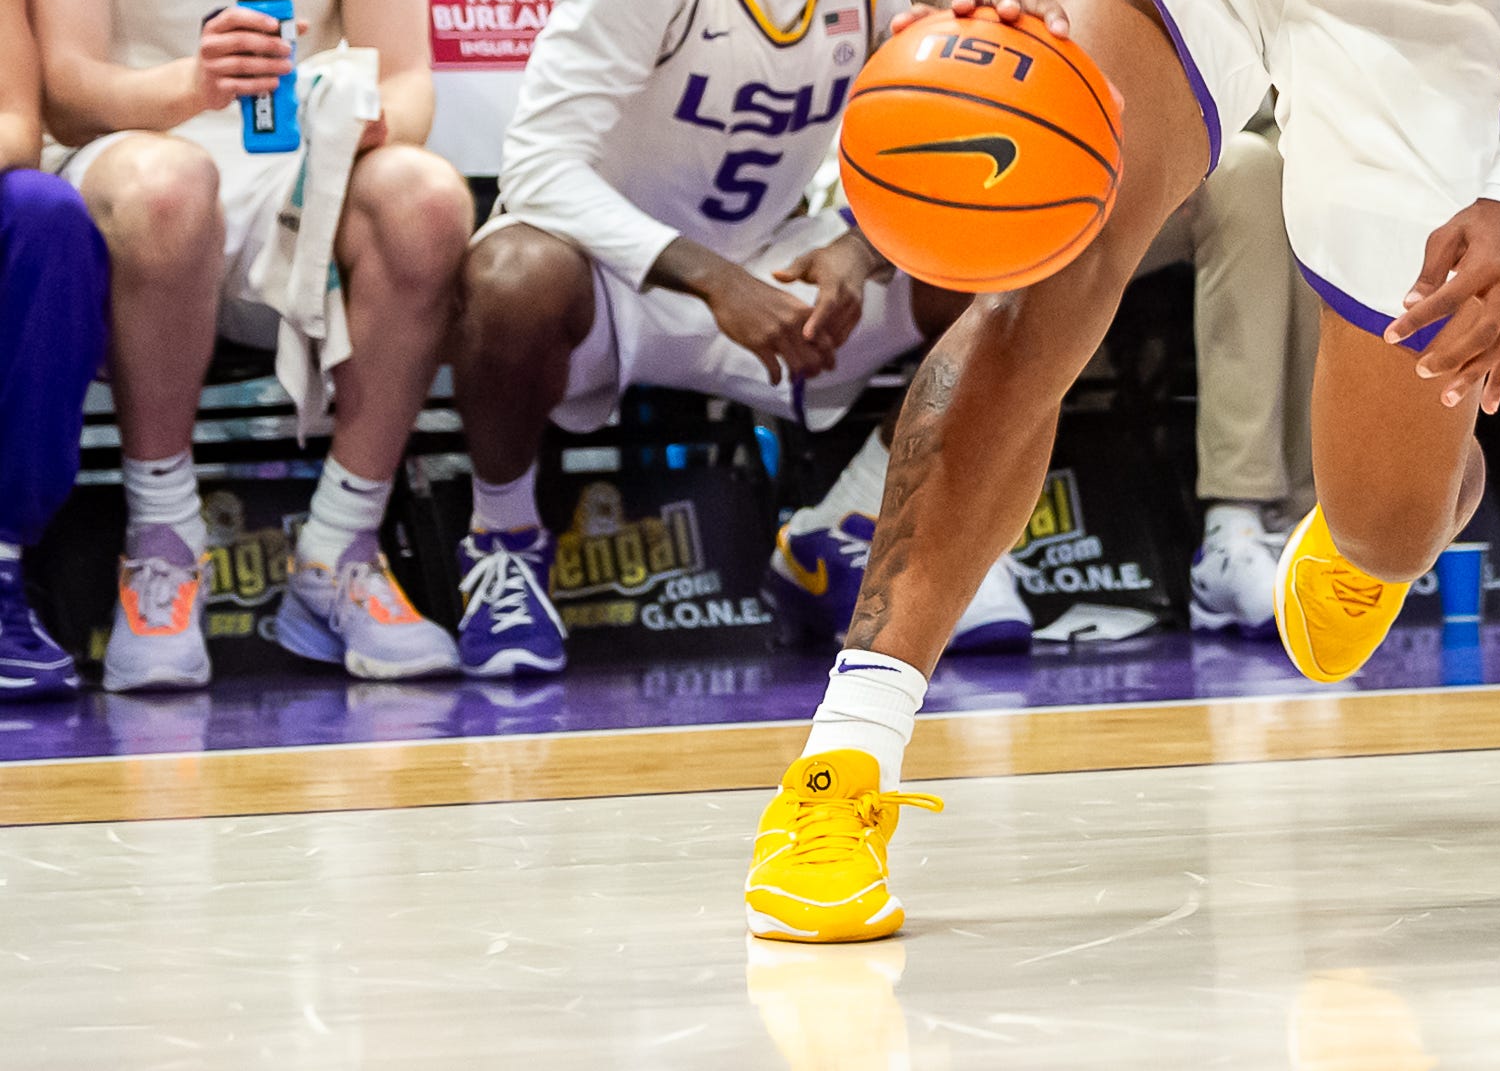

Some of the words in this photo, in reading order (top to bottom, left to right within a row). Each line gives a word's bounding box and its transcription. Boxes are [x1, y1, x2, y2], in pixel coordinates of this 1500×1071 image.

[915, 33, 1034, 82] LSU
[674, 73, 851, 138] LSU
[699, 148, 784, 223] 5
[552, 511, 693, 587] engal
